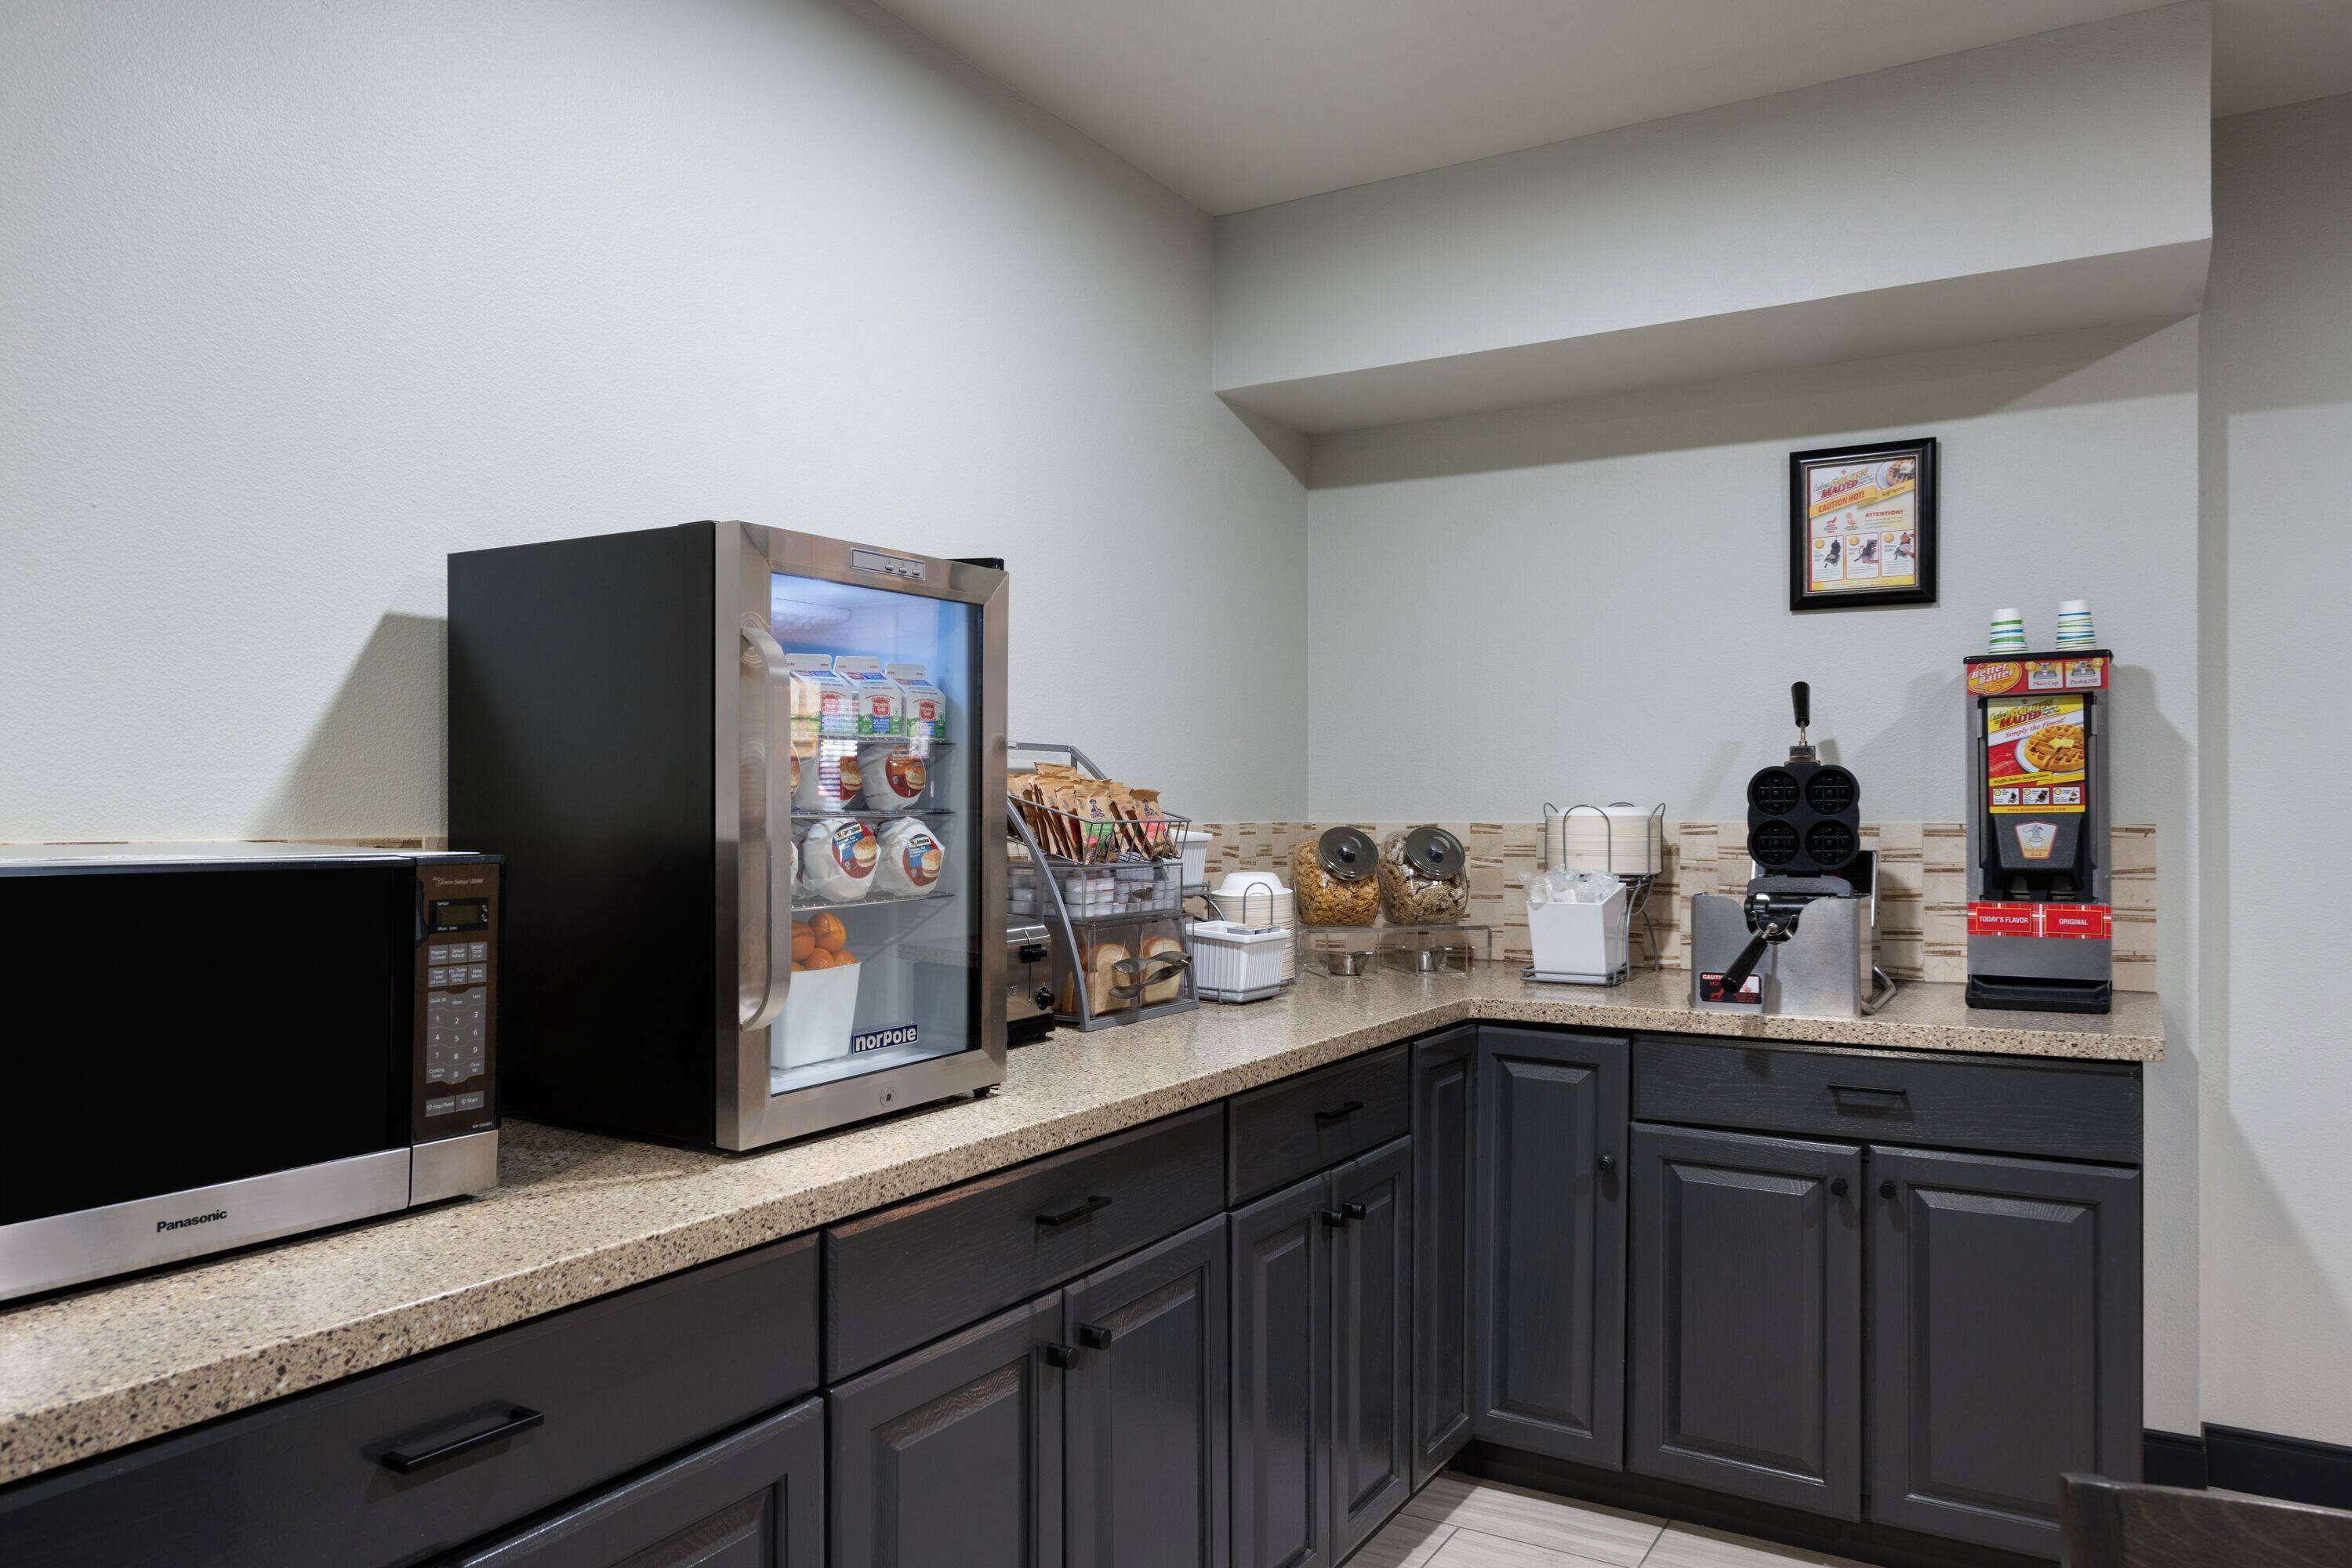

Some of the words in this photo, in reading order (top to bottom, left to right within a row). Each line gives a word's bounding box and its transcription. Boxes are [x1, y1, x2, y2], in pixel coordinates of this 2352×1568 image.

[1819, 496, 1848, 513] CAUTION
[1848, 490, 1865, 503] HOT!
[1865, 509, 1904, 517] ATTENTION!
[1972, 662, 2007, 679] Better
[1979, 670, 2013, 684] Batter
[2005, 727, 2028, 738] Simply
[855, 1028, 916, 1051] norpole
[156, 1209, 227, 1233] Panasonic
